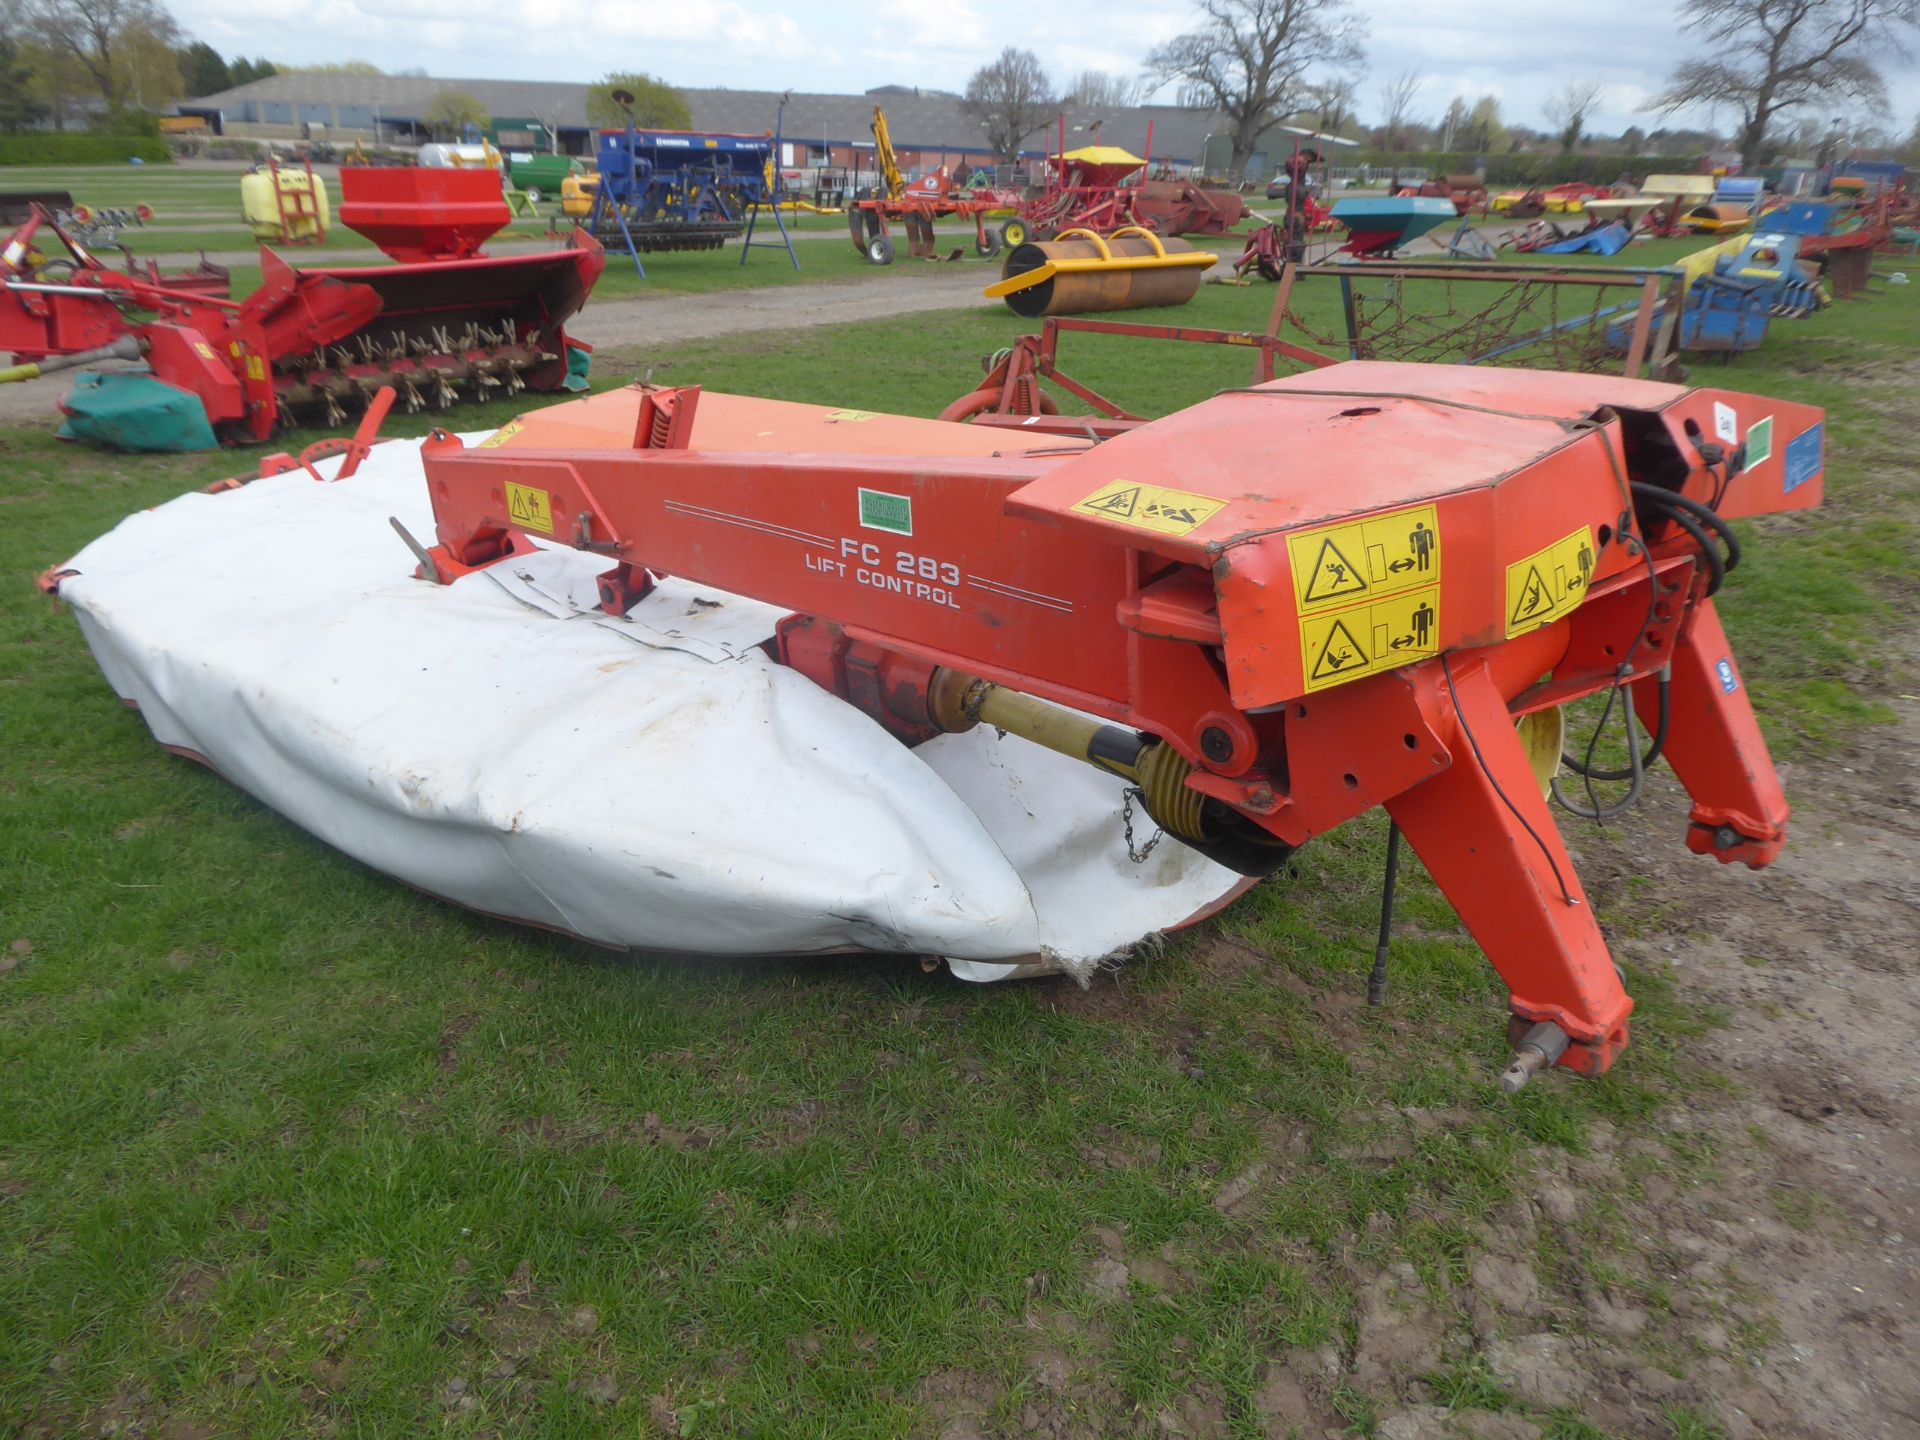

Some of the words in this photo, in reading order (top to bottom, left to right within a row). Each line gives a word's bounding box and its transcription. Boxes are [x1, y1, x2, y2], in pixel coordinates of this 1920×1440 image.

[806, 553, 846, 577] LIFT
[857, 568, 960, 609] CONTROL
[841, 537, 880, 566] FC
[896, 551, 960, 586] 283
